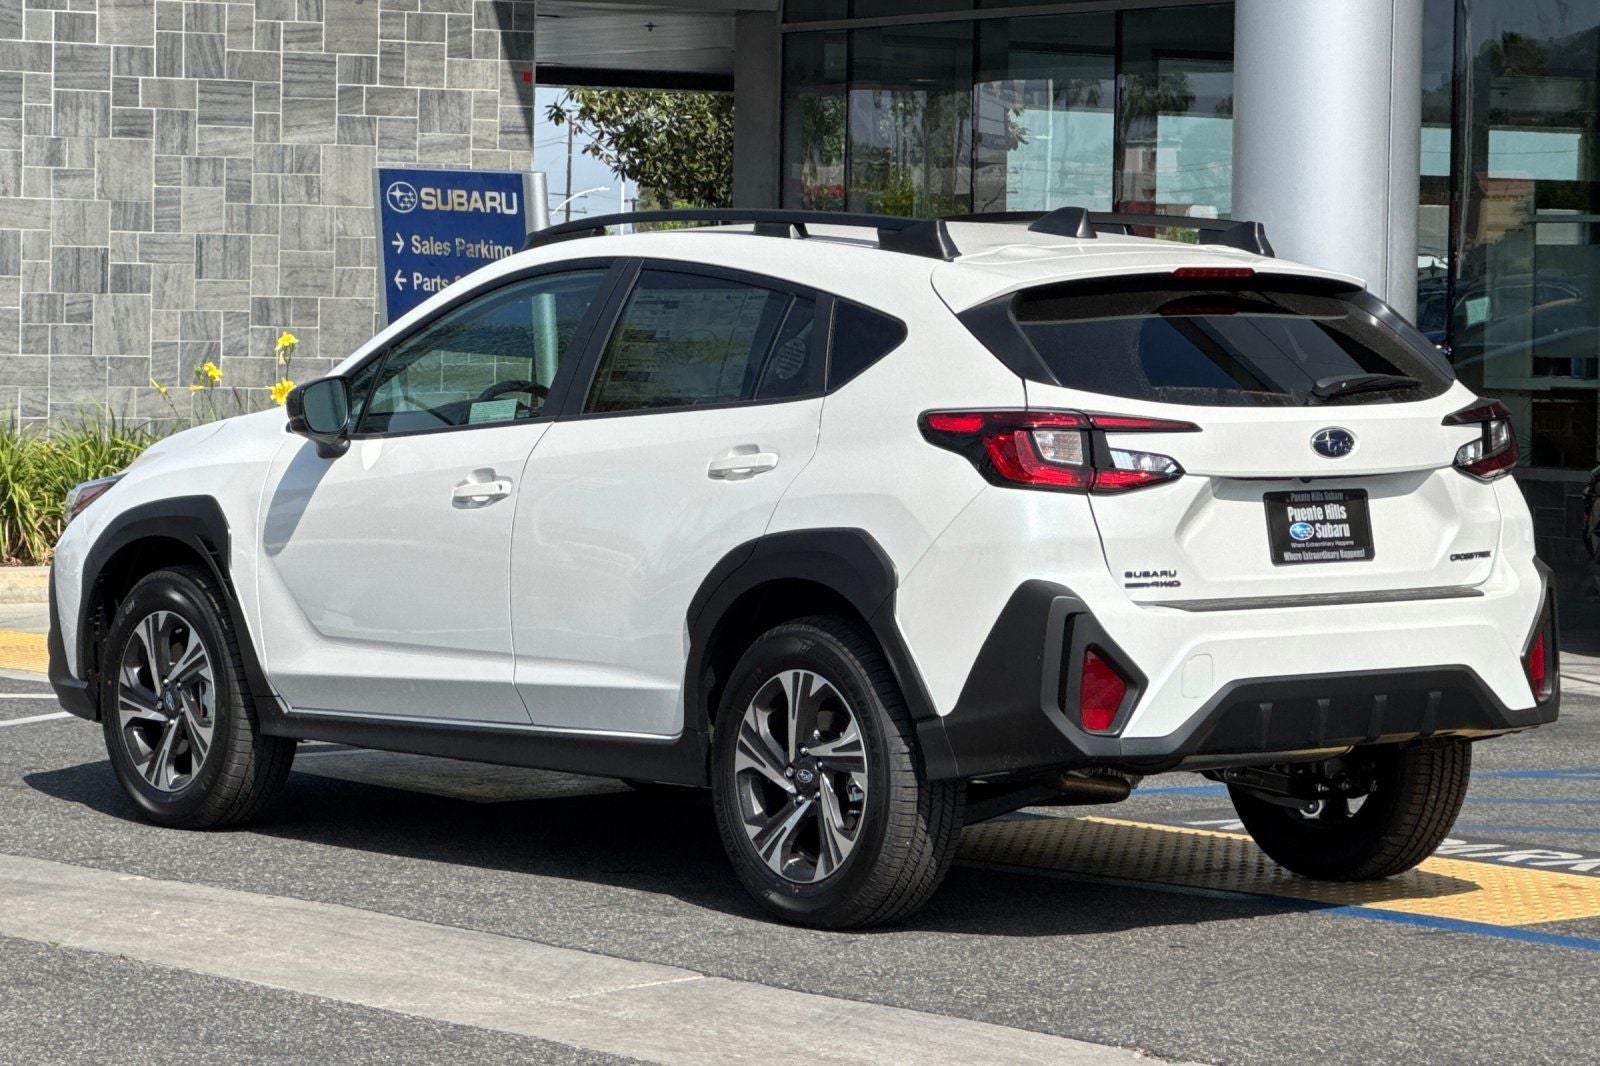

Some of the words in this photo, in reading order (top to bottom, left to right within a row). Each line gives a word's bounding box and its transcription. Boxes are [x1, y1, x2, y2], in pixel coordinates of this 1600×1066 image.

[420, 187, 518, 215] SUBARU
[411, 235, 451, 256] Sales
[412, 271, 450, 292] Parts
[1287, 505, 1323, 522] Puente
[1324, 503, 1347, 520] Hills
[1315, 522, 1351, 538] Subaru
[1283, 552, 1302, 561] Where
[1302, 550, 1340, 560] Extraordinary
[1124, 570, 1177, 578] SUBARU
